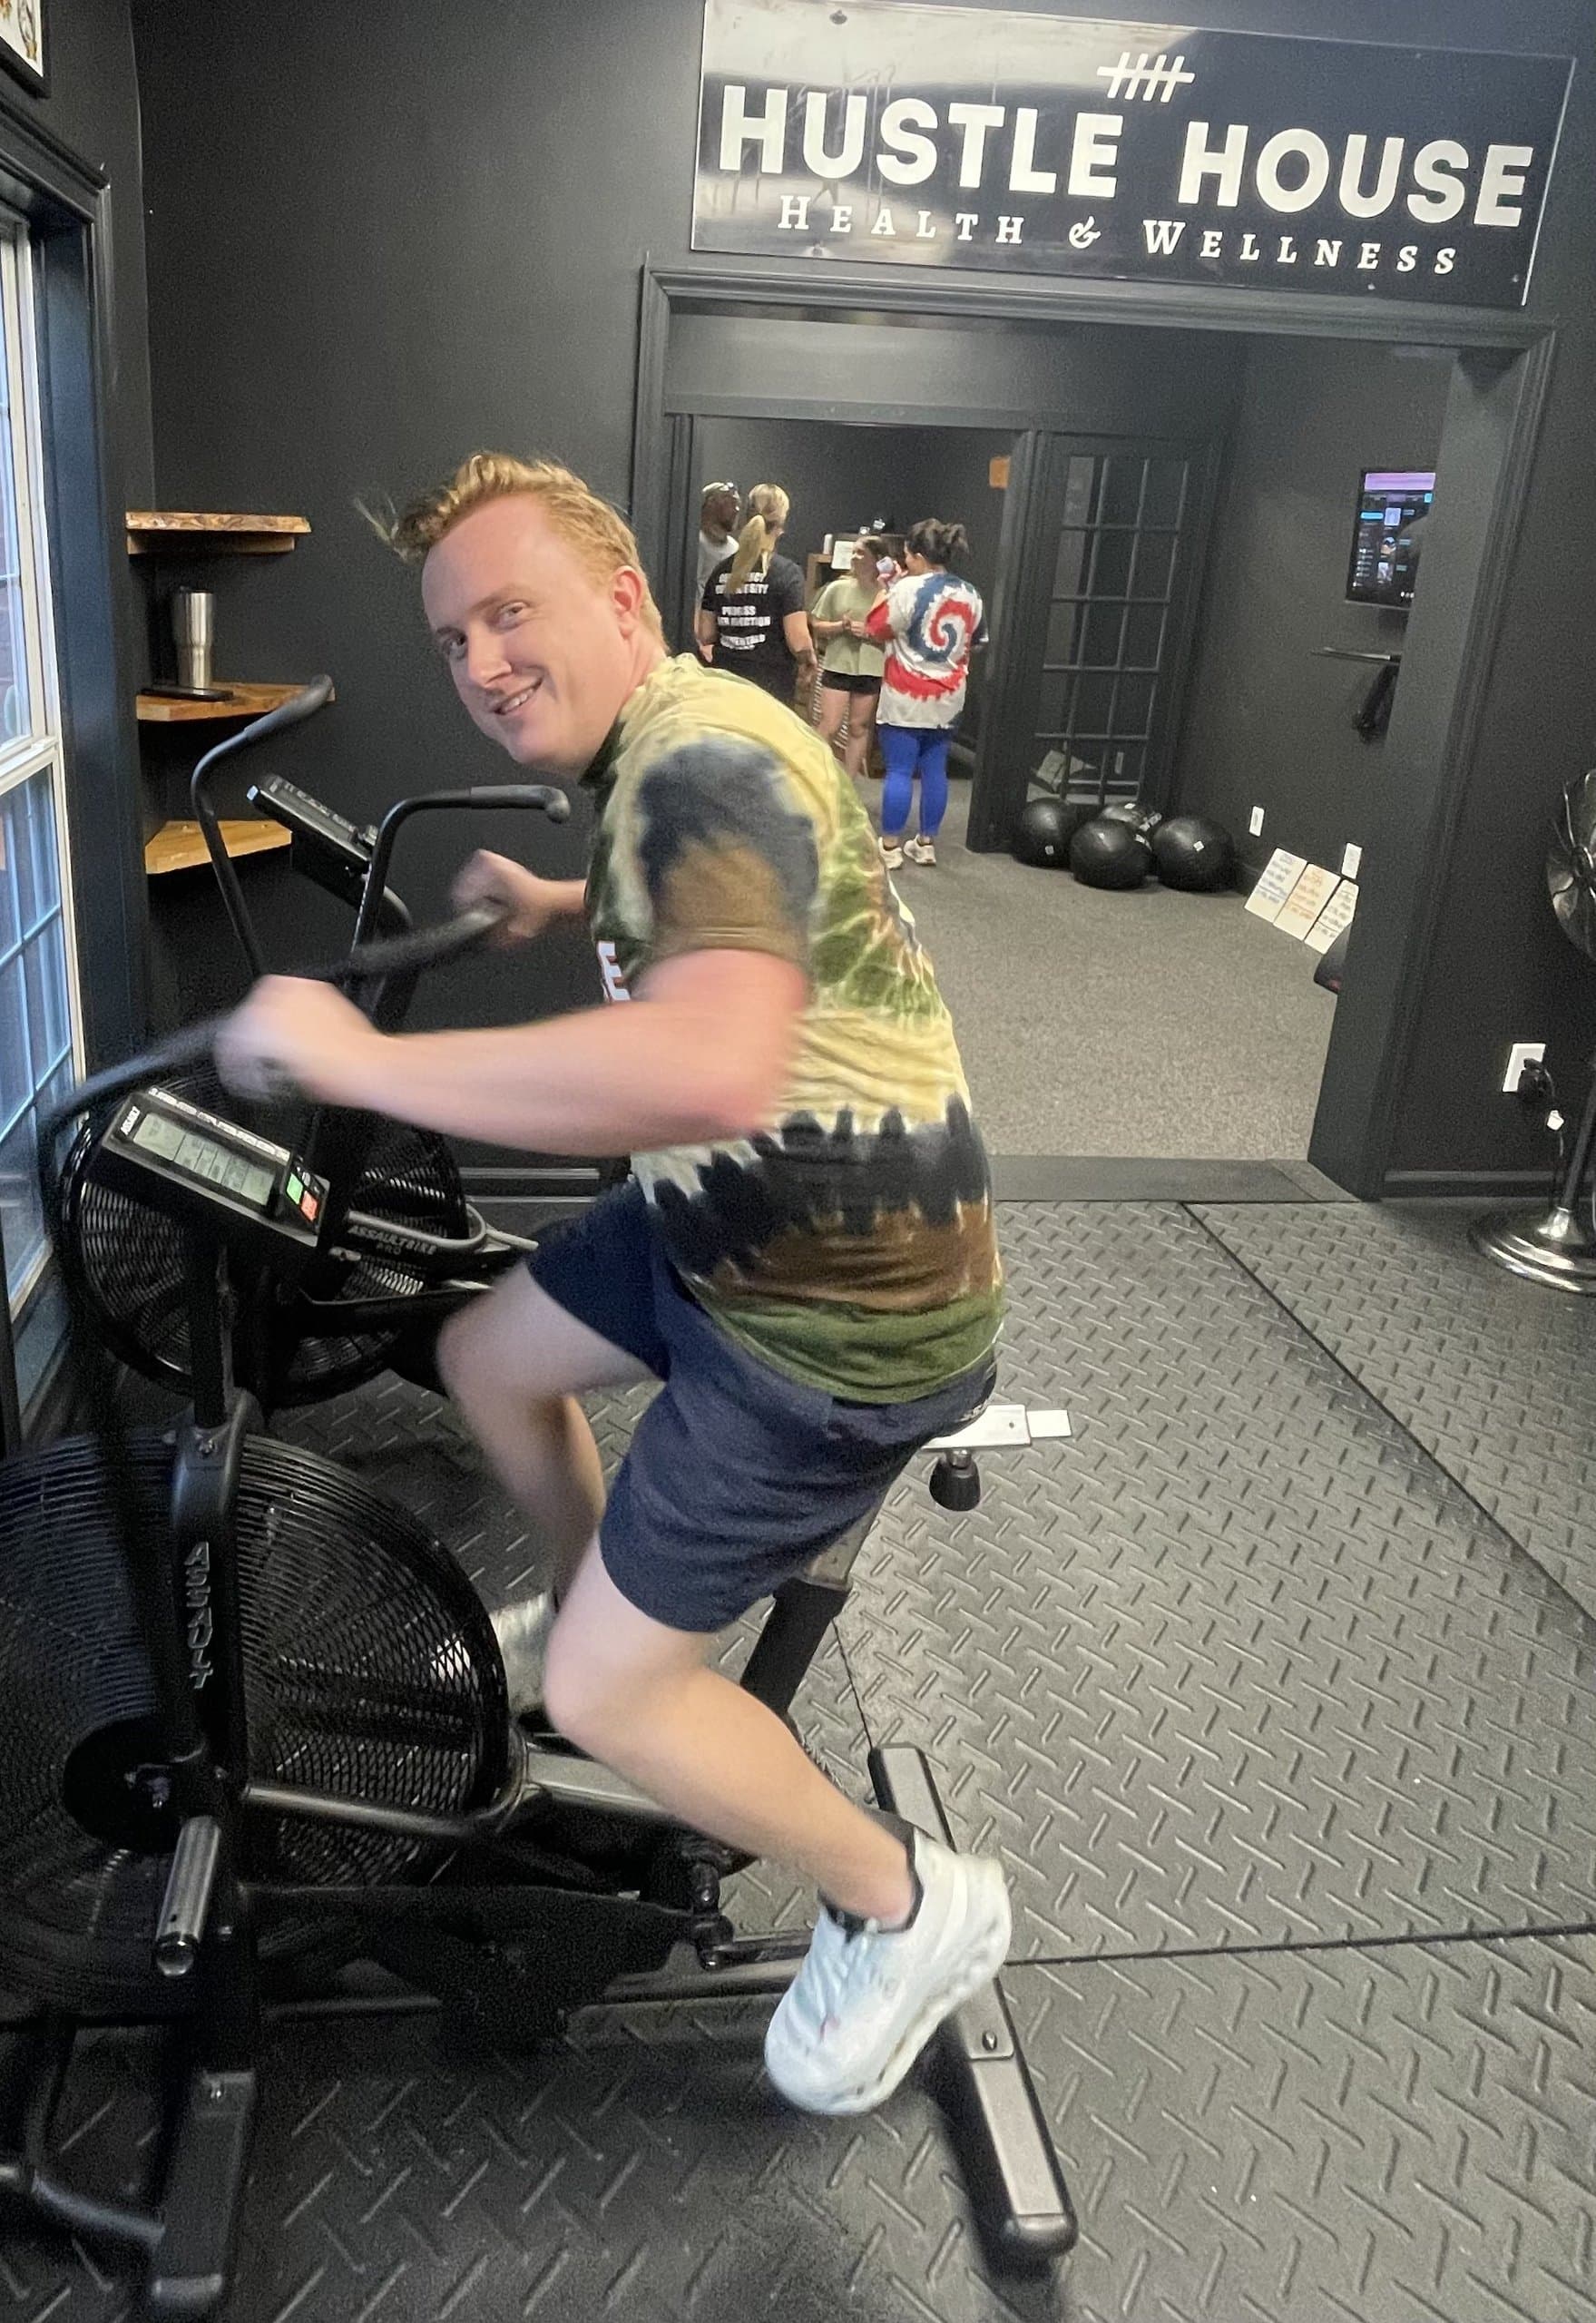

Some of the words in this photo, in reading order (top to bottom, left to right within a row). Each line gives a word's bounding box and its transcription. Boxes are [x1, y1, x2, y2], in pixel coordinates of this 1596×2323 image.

[720, 85, 1123, 198] HUSTLE
[1179, 122, 1533, 227] HOUSE
[1069, 216, 1101, 249] &
[184, 1542, 214, 1690] ASSAULT
